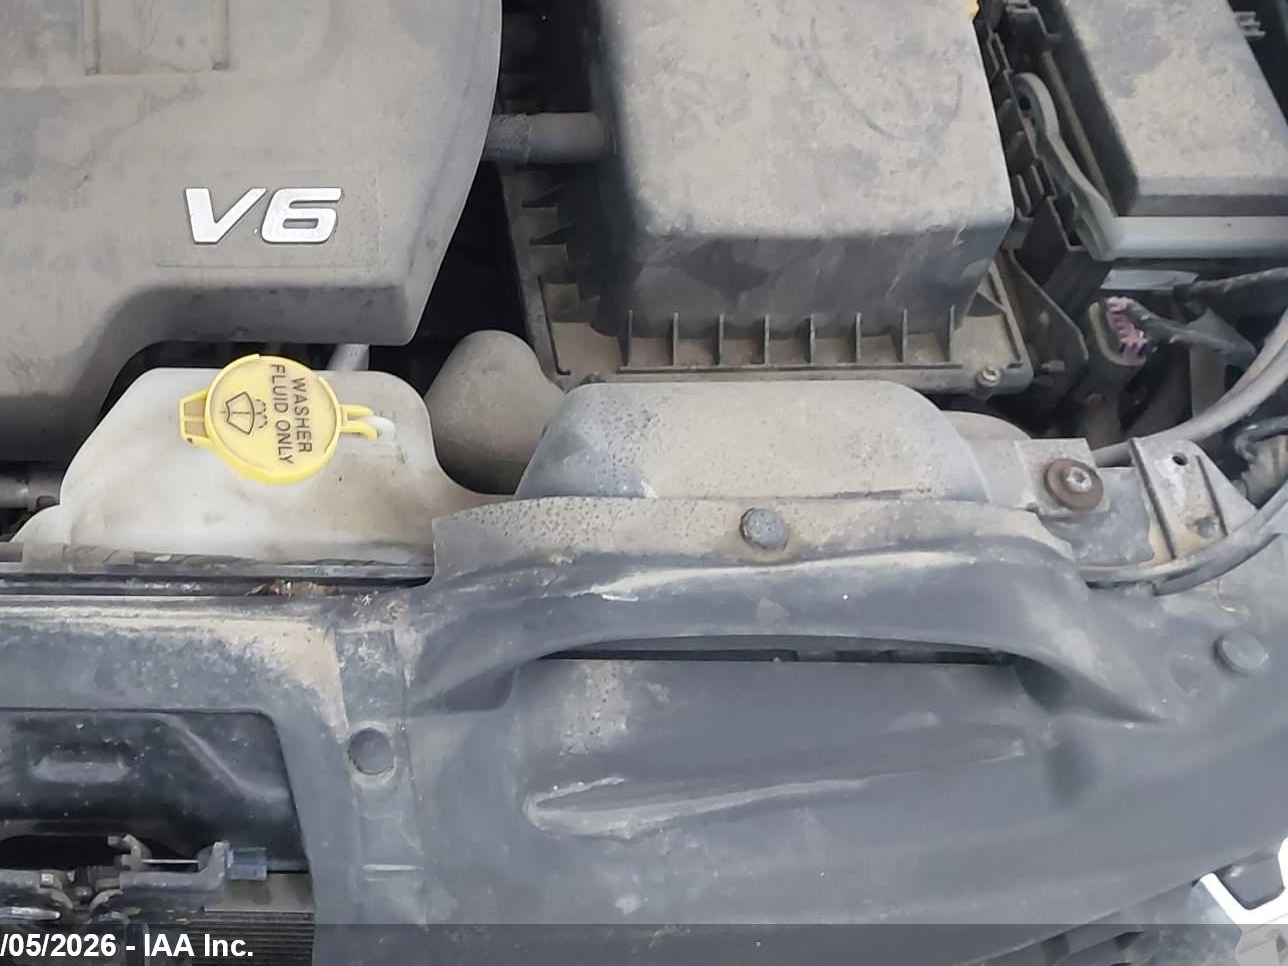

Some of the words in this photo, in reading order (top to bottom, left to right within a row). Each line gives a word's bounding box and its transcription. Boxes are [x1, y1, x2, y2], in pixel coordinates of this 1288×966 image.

[184, 187, 343, 245] V6
[270, 363, 289, 414] FLUID
[291, 377, 313, 453] WASHER
[275, 420, 295, 465] ONLY
